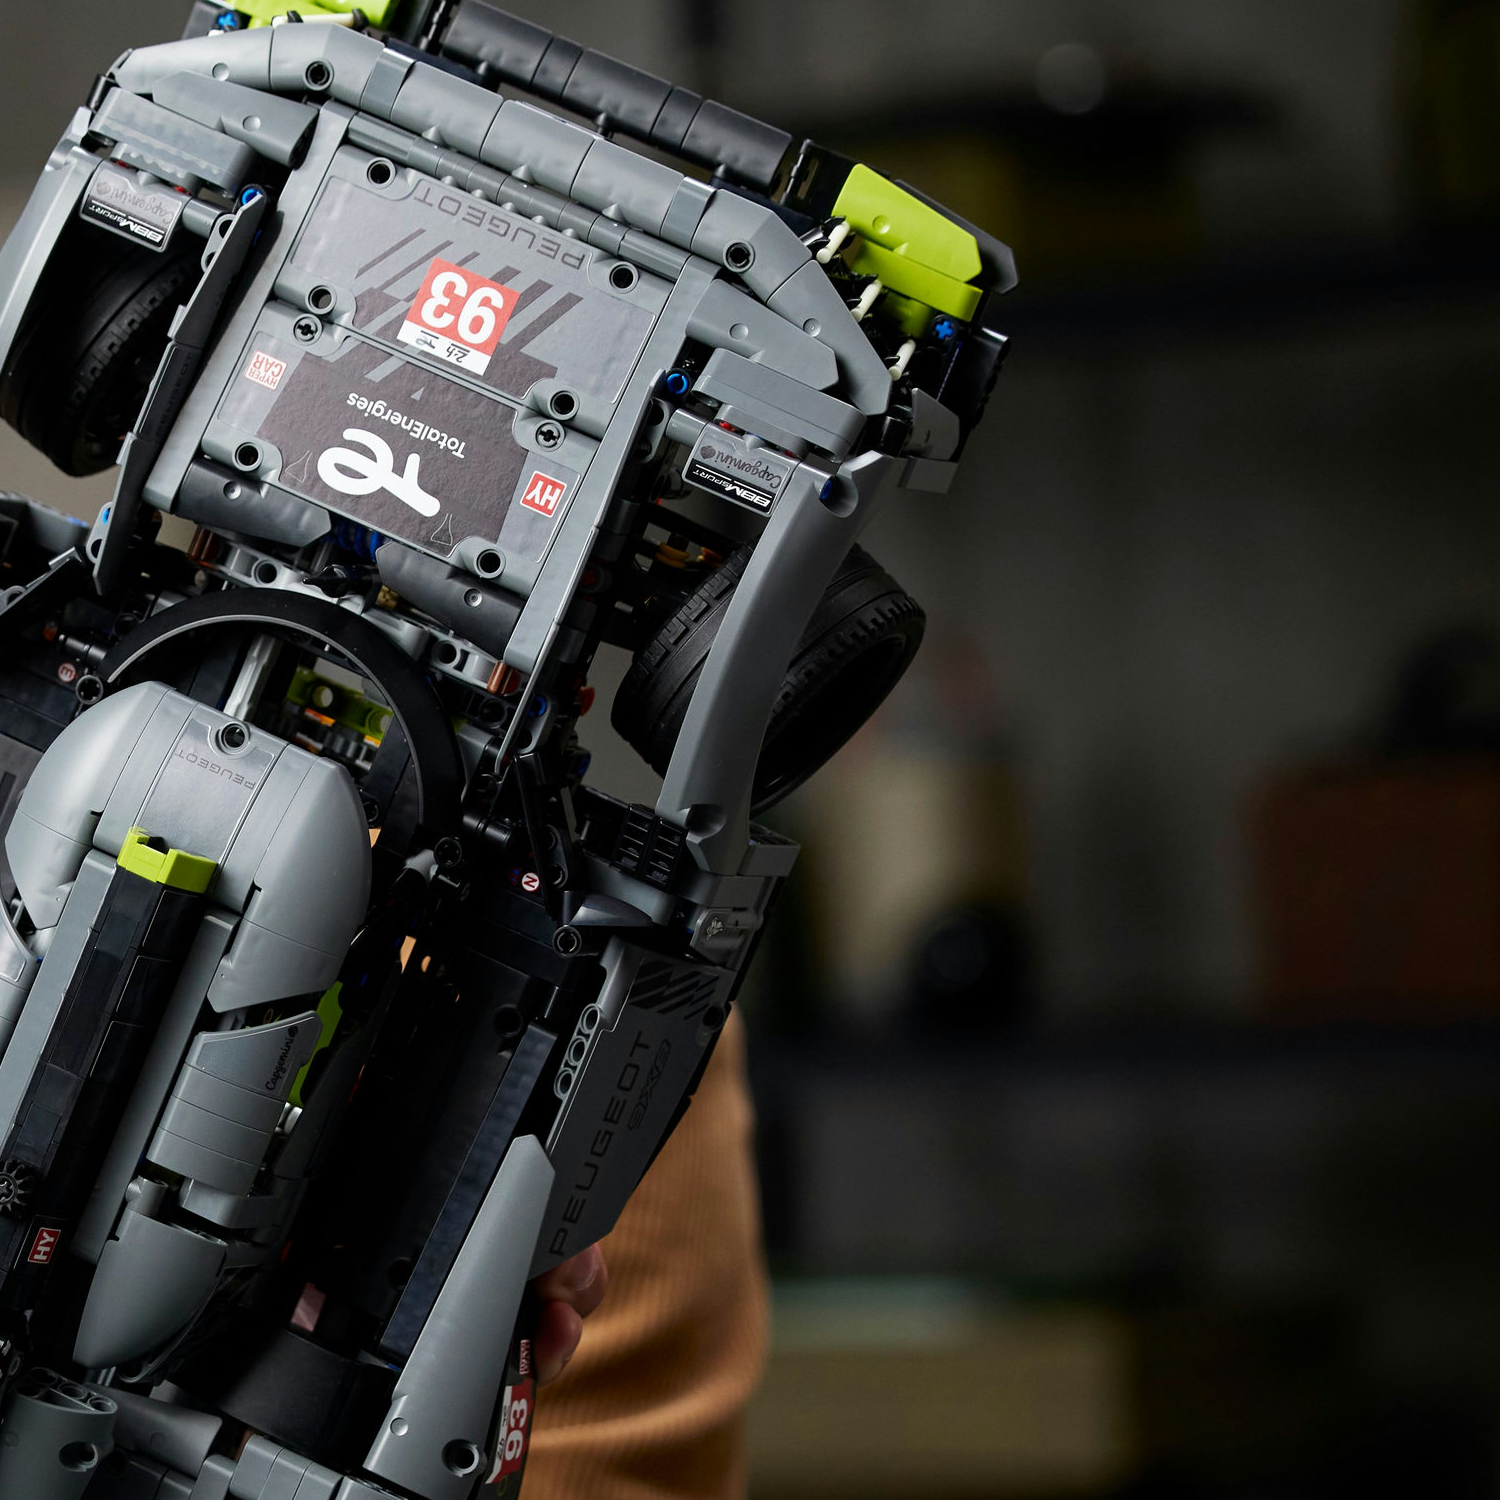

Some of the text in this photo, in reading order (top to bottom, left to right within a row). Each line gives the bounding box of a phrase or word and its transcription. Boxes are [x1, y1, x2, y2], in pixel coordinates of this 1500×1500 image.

[110, 185, 174, 225] Capgemini
[412, 178, 585, 269] PEUGEOT
[421, 270, 506, 345] 93
[249, 368, 277, 387] HYPER
[253, 354, 283, 378] CAR
[344, 390, 467, 458] TotalEnergies
[715, 450, 782, 490] Capgemini
[524, 480, 560, 510] HY
[175, 748, 257, 791] PEUGEOT
[523, 875, 538, 889] N
[265, 1037, 294, 1091] Capgemini
[549, 1030, 650, 1257] PEUGEOT
[32, 1230, 58, 1263] HY
[506, 1398, 528, 1461] 93
